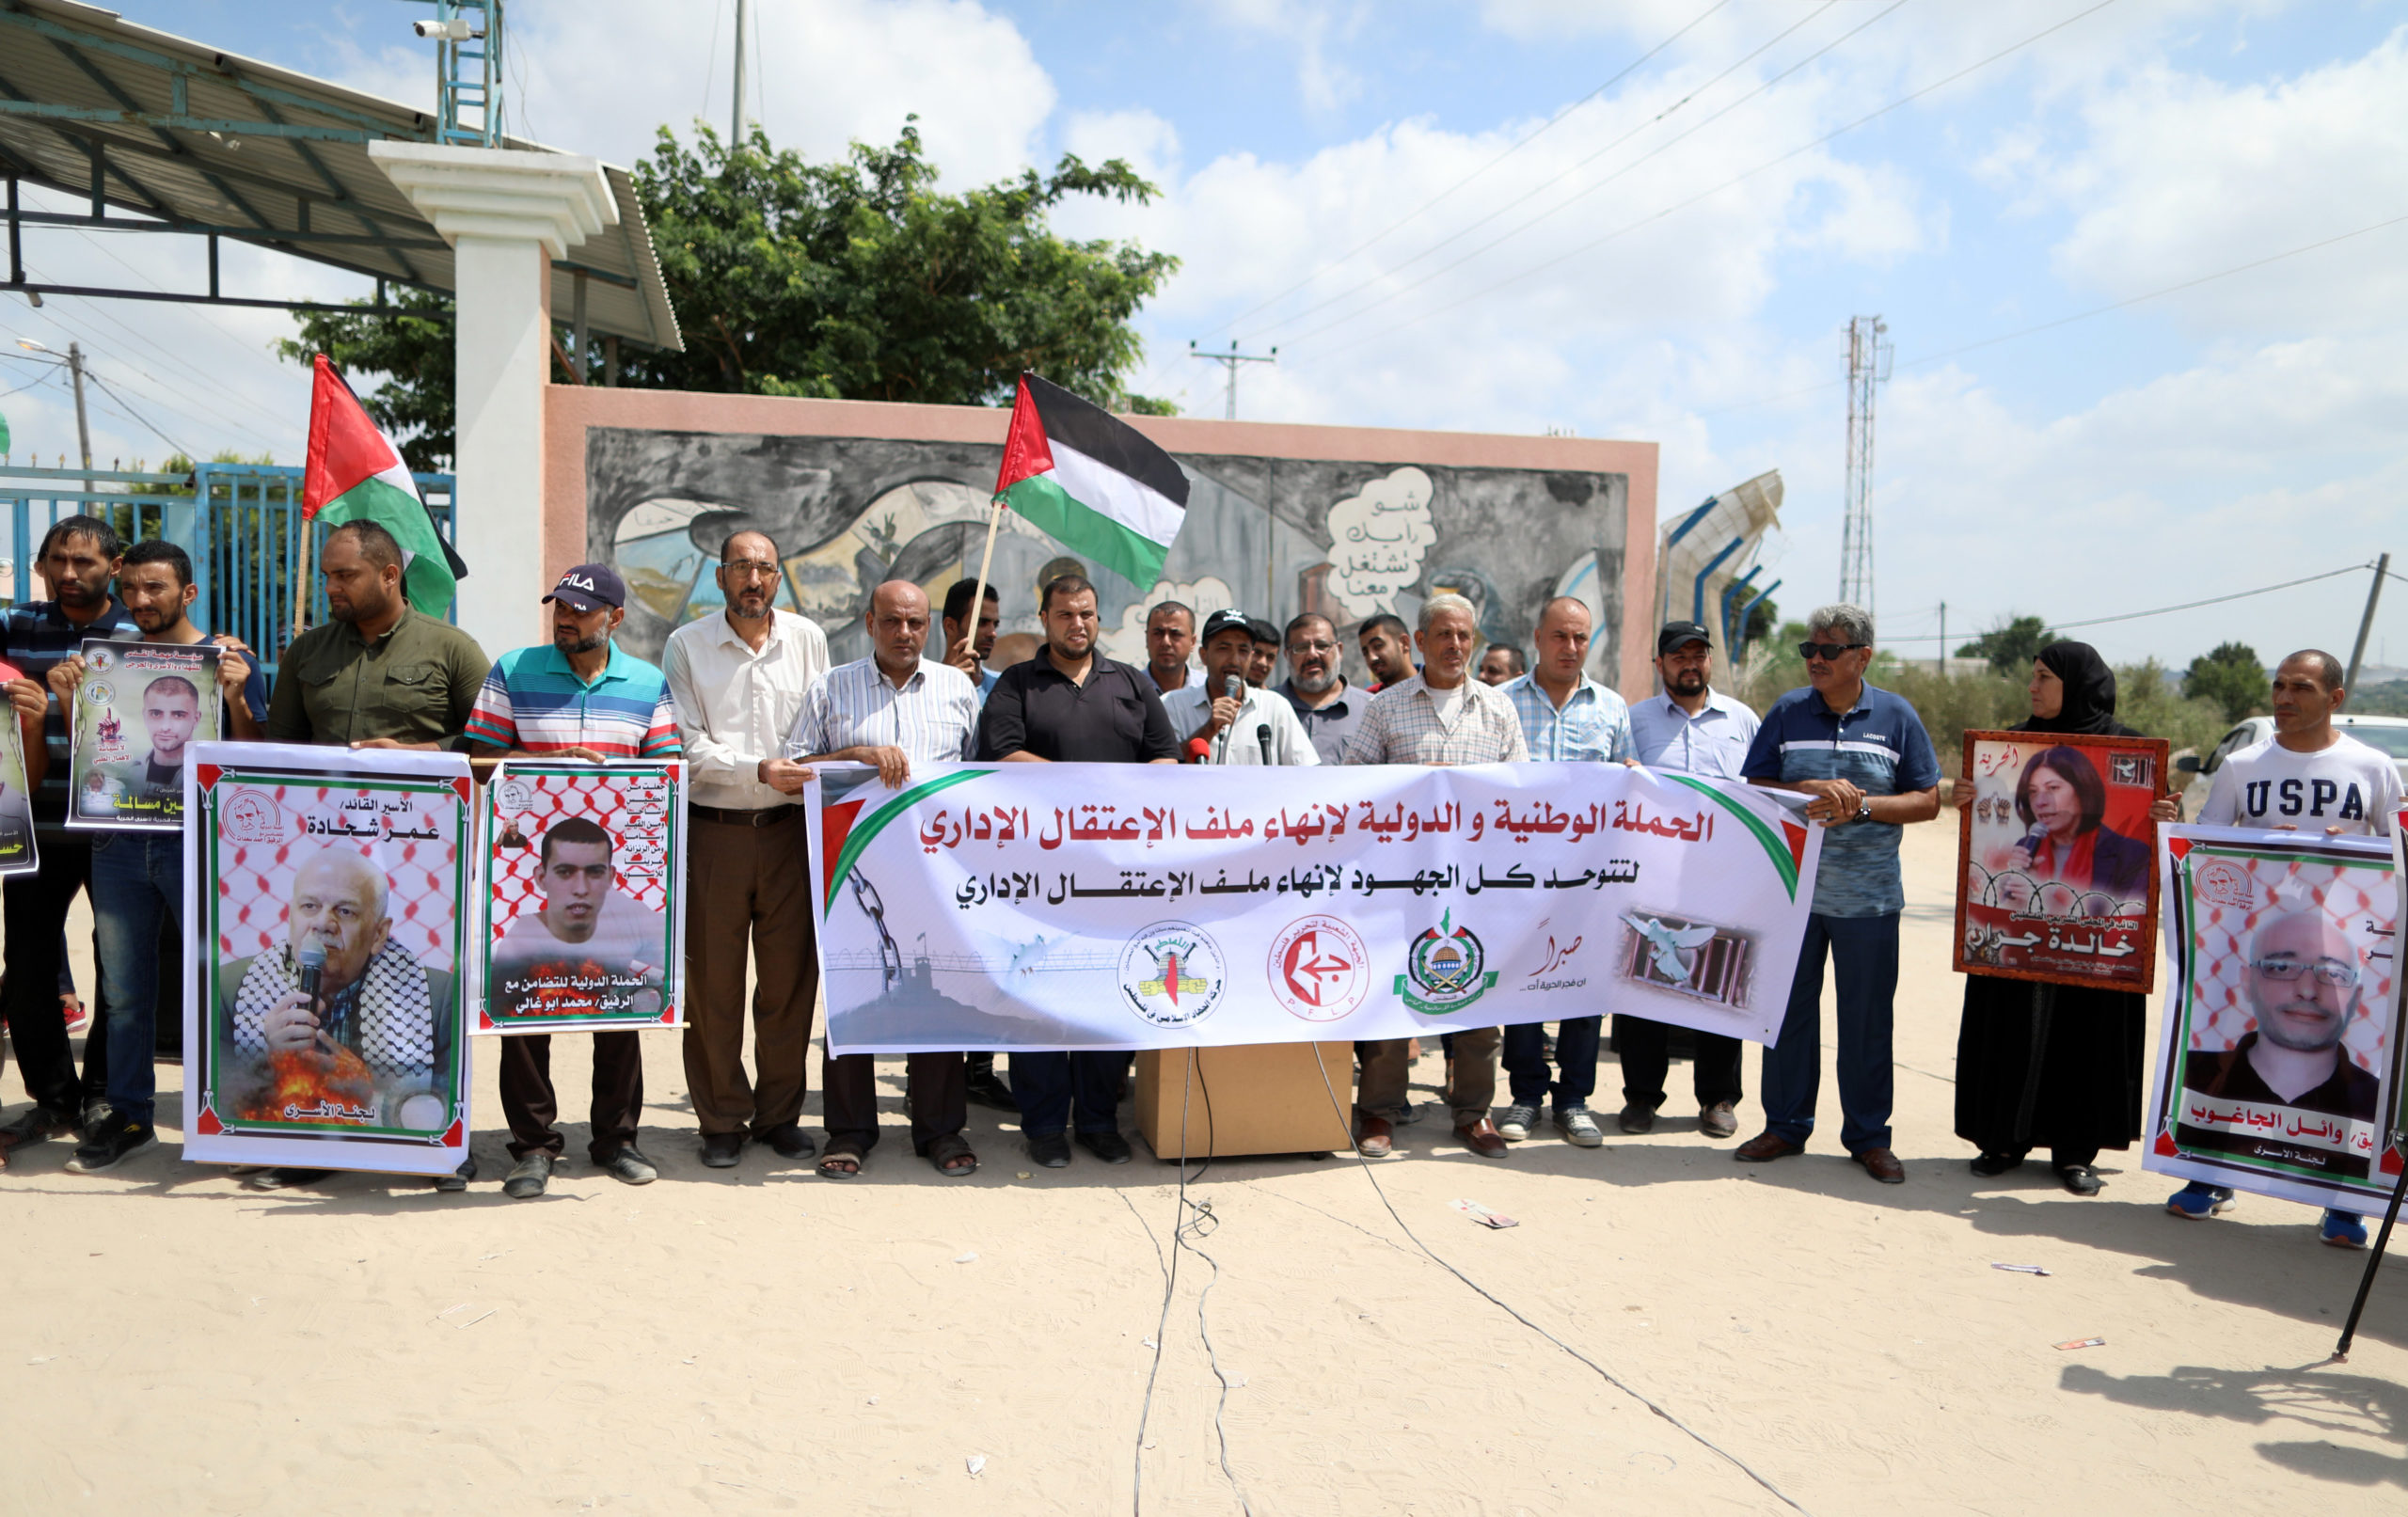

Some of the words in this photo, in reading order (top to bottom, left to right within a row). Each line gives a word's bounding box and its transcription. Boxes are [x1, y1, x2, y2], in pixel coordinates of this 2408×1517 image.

[1370, 491, 1419, 516] شو
[559, 574, 594, 592] FILA
[1347, 579, 1388, 596] معنا
[1863, 732, 1886, 742] LACOSTE
[1979, 743, 2019, 777] الحرية
[381, 798, 413, 816] الأسير
[2246, 779, 2363, 821] USPA
[308, 815, 379, 837] شحادة
[383, 825, 439, 843] عمر
[920, 805, 1029, 854] الإداري
[1039, 804, 1176, 850] الإعتقال
[1185, 805, 1254, 840] ملف
[1263, 802, 1350, 846] لإنهاء
[1357, 800, 1461, 843] الدولية
[1465, 811, 1485, 843] و
[1494, 799, 1607, 844] الوطنية
[1611, 799, 1714, 843] الحملة
[1047, 871, 1193, 905] الإعتقال
[1200, 868, 1270, 894] ملف
[1276, 863, 1343, 898] لإنهاء
[1352, 862, 1460, 896] الجهود
[1465, 862, 1535, 895] كل
[1544, 859, 1640, 890] لتتوحد
[956, 871, 1039, 910] الإداري
[2049, 927, 2135, 957] خالدة
[504, 979, 519, 994] مع
[521, 973, 568, 992] للتضامن
[570, 974, 609, 990] الدولية
[611, 973, 647, 988] الحملة
[515, 995, 543, 1014] غالي
[562, 998, 592, 1008] محمد
[285, 1100, 335, 1119] الأسرى
[337, 1104, 376, 1122] لجنة
[2190, 1103, 2282, 1130] الجاغوب
[2286, 1116, 2343, 1145] وائل
[2294, 1149, 2326, 1165] لجنة
